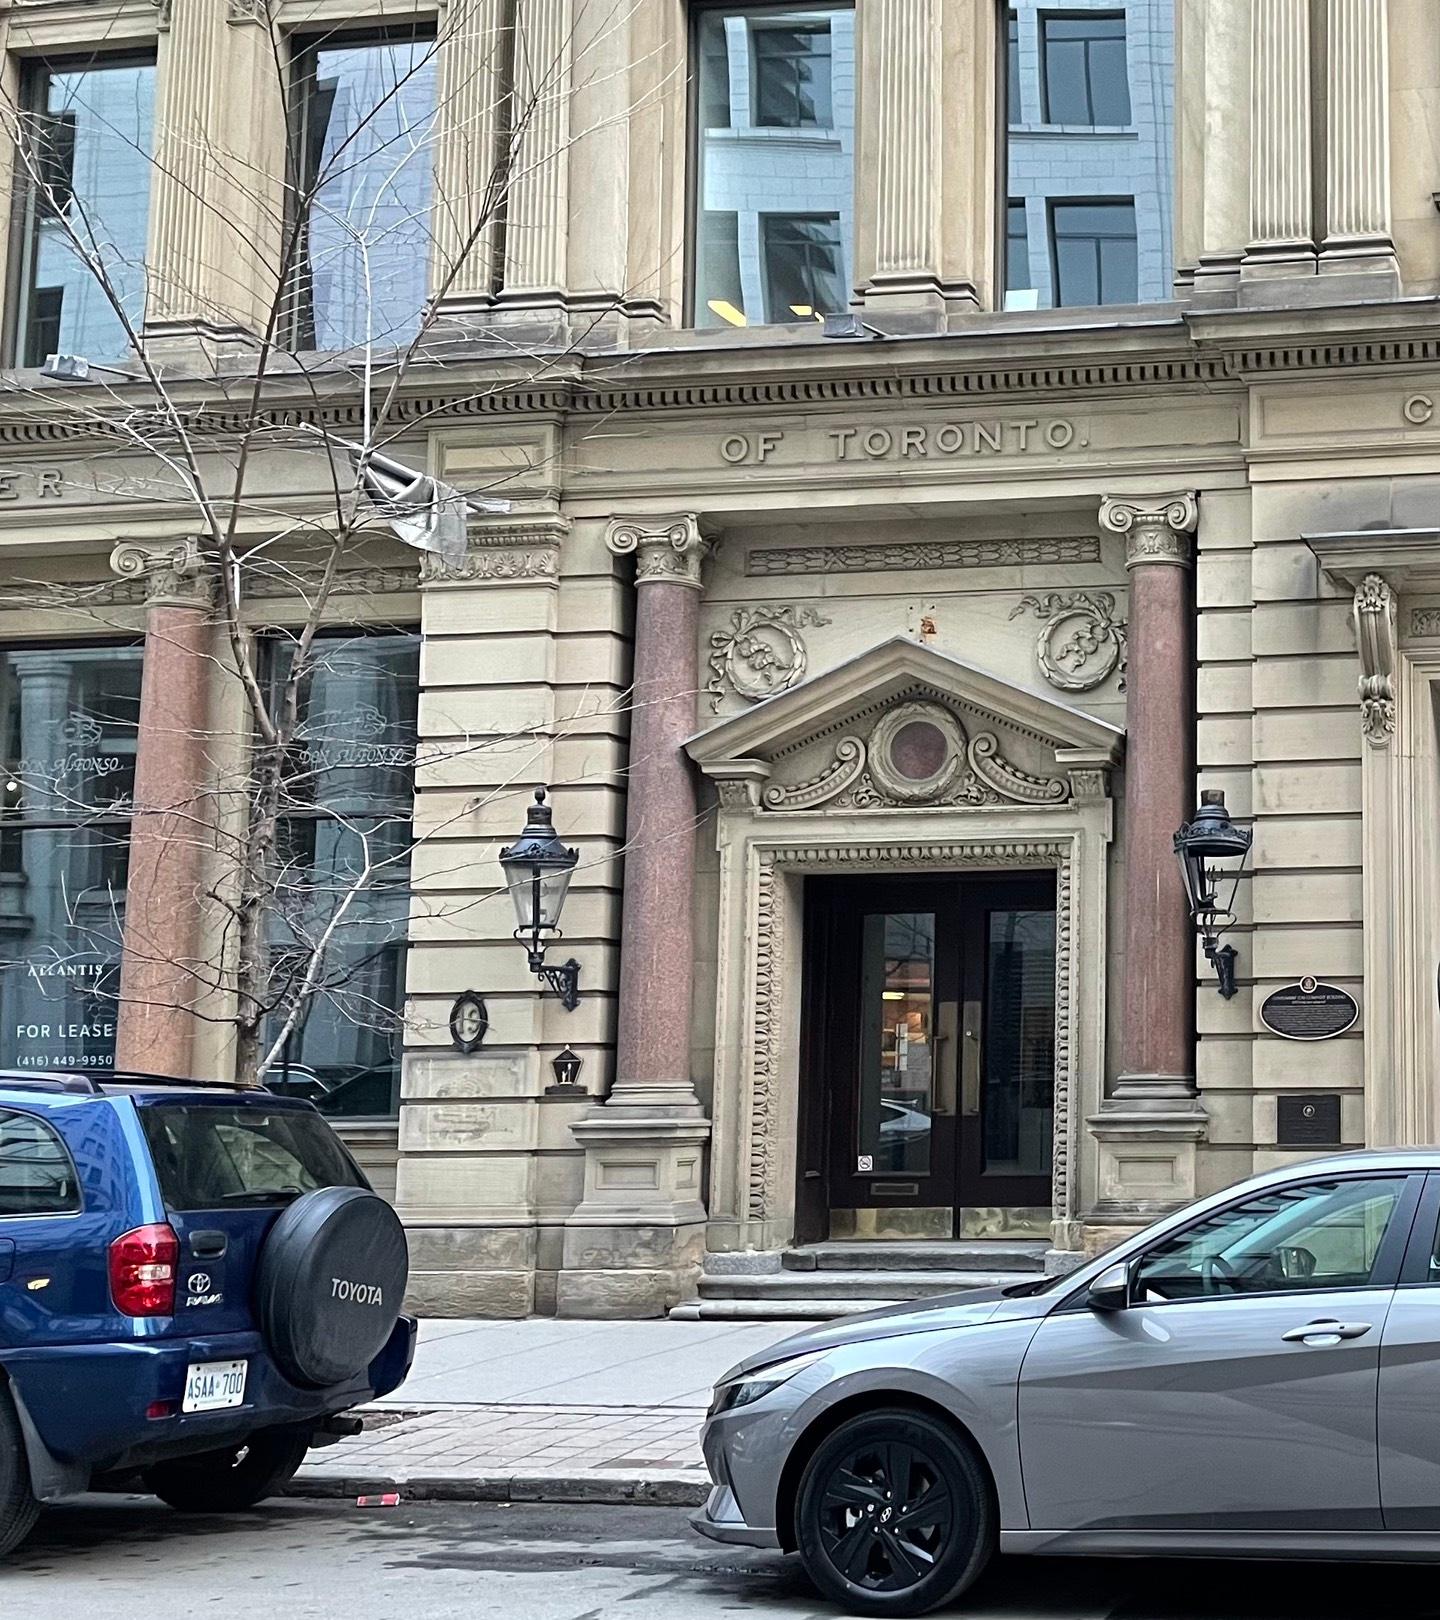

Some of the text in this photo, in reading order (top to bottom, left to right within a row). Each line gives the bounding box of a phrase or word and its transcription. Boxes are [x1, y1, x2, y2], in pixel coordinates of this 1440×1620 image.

[720, 419, 1090, 463] OF TORONTO.
[17, 1024, 113, 1038] FOR LEASE
[456, 1008, 481, 1035] 19
[16, 1056, 113, 1067] (416) 449-9950
[331, 1278, 383, 1306] TOYOTA
[222, 1373, 243, 1395] 700
